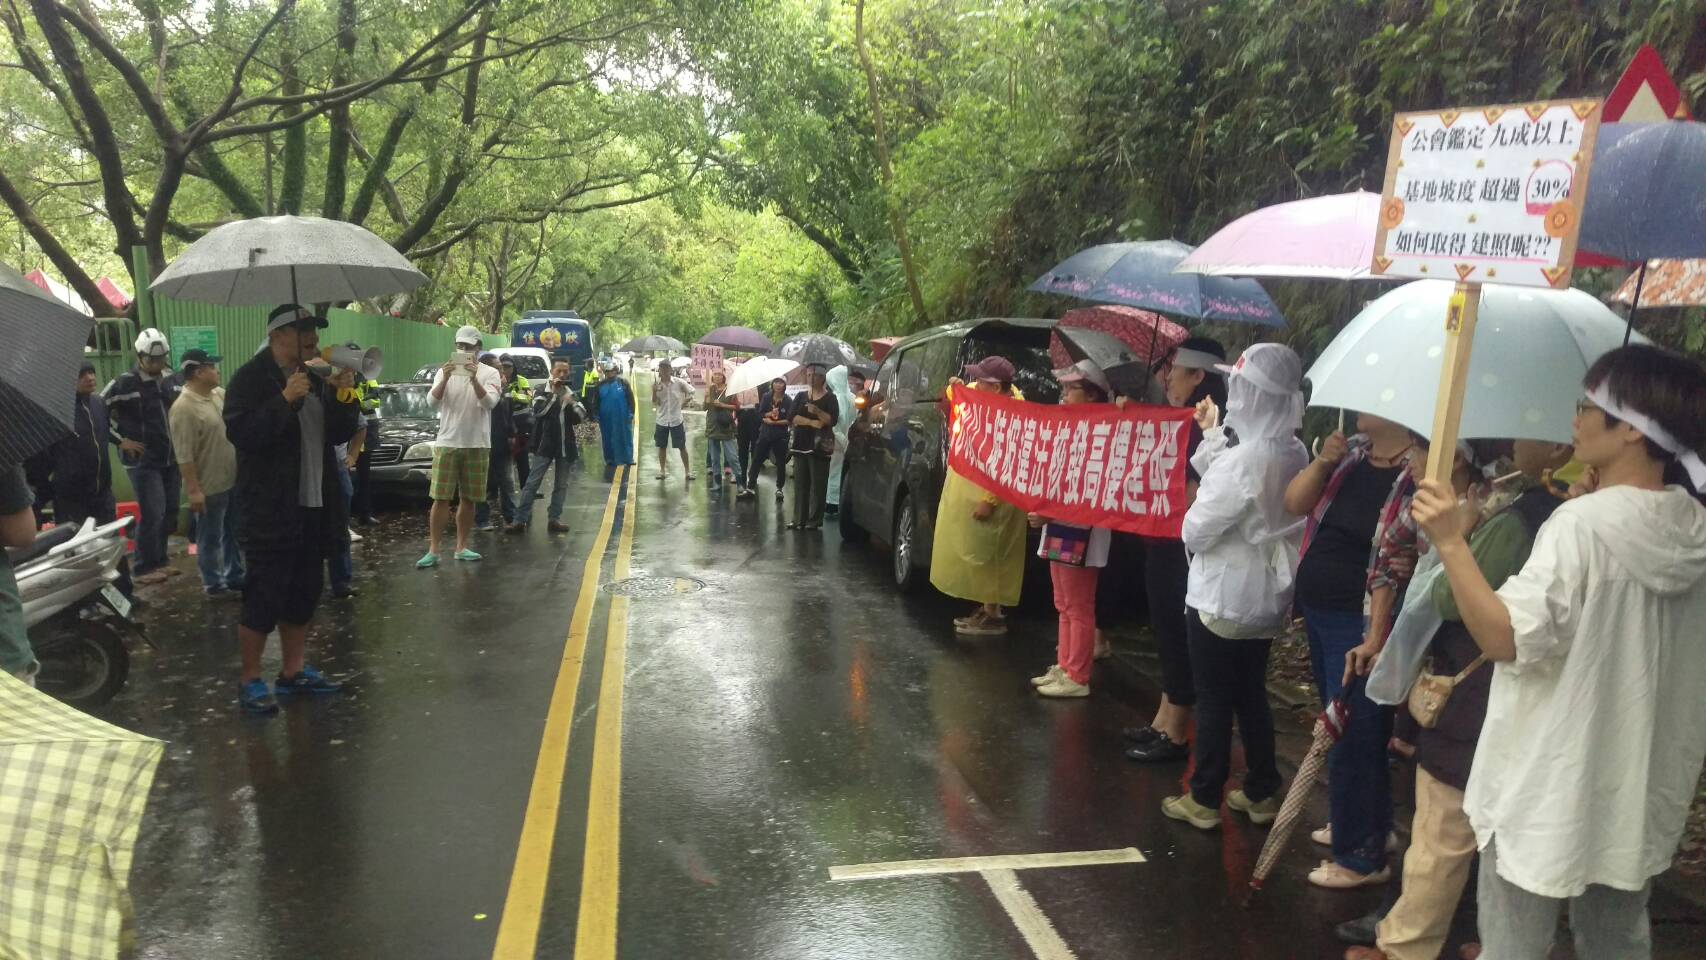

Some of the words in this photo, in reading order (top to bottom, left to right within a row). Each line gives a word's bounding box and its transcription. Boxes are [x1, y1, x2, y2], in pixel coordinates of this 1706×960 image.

[1411, 125, 1485, 152] 公會鑑定
[1489, 119, 1573, 147] 九成以上
[1404, 177, 1477, 203] 基地坡度
[1479, 176, 1521, 203] 超過
[1531, 178, 1570, 199] 30%
[1396, 230, 1466, 255] 如何取得
